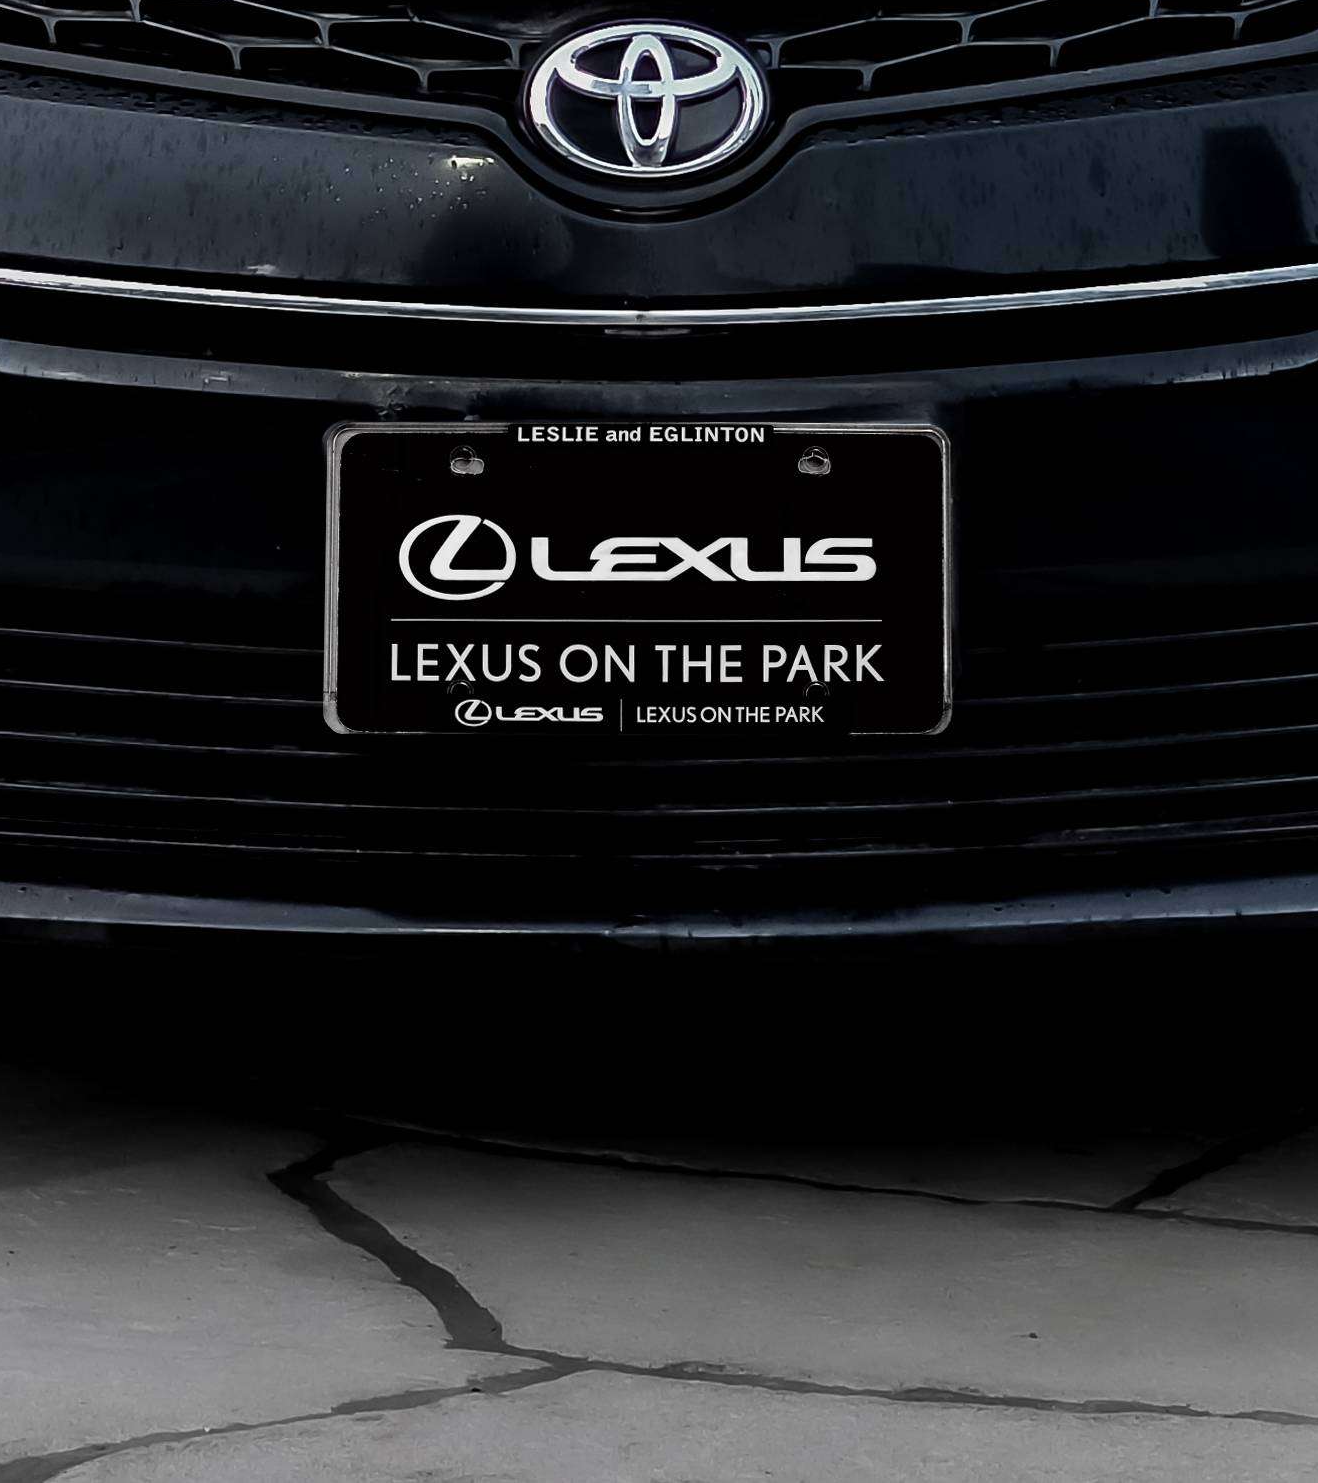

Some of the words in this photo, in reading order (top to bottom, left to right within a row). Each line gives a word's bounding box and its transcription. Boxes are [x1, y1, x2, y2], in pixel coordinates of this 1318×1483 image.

[517, 426, 599, 443] LESLIE
[605, 426, 642, 443] and
[649, 426, 766, 443] EGLINTON
[531, 537, 877, 581] LEXUS
[391, 644, 541, 683] LEXUS
[560, 644, 635, 683] ON
[655, 645, 743, 683] THE
[762, 644, 885, 683] PARK
[495, 706, 604, 723] LEXUS
[636, 706, 697, 723] LEXUS
[700, 706, 732, 723] ON
[735, 706, 771, 723] THE
[775, 706, 825, 723] PARK
